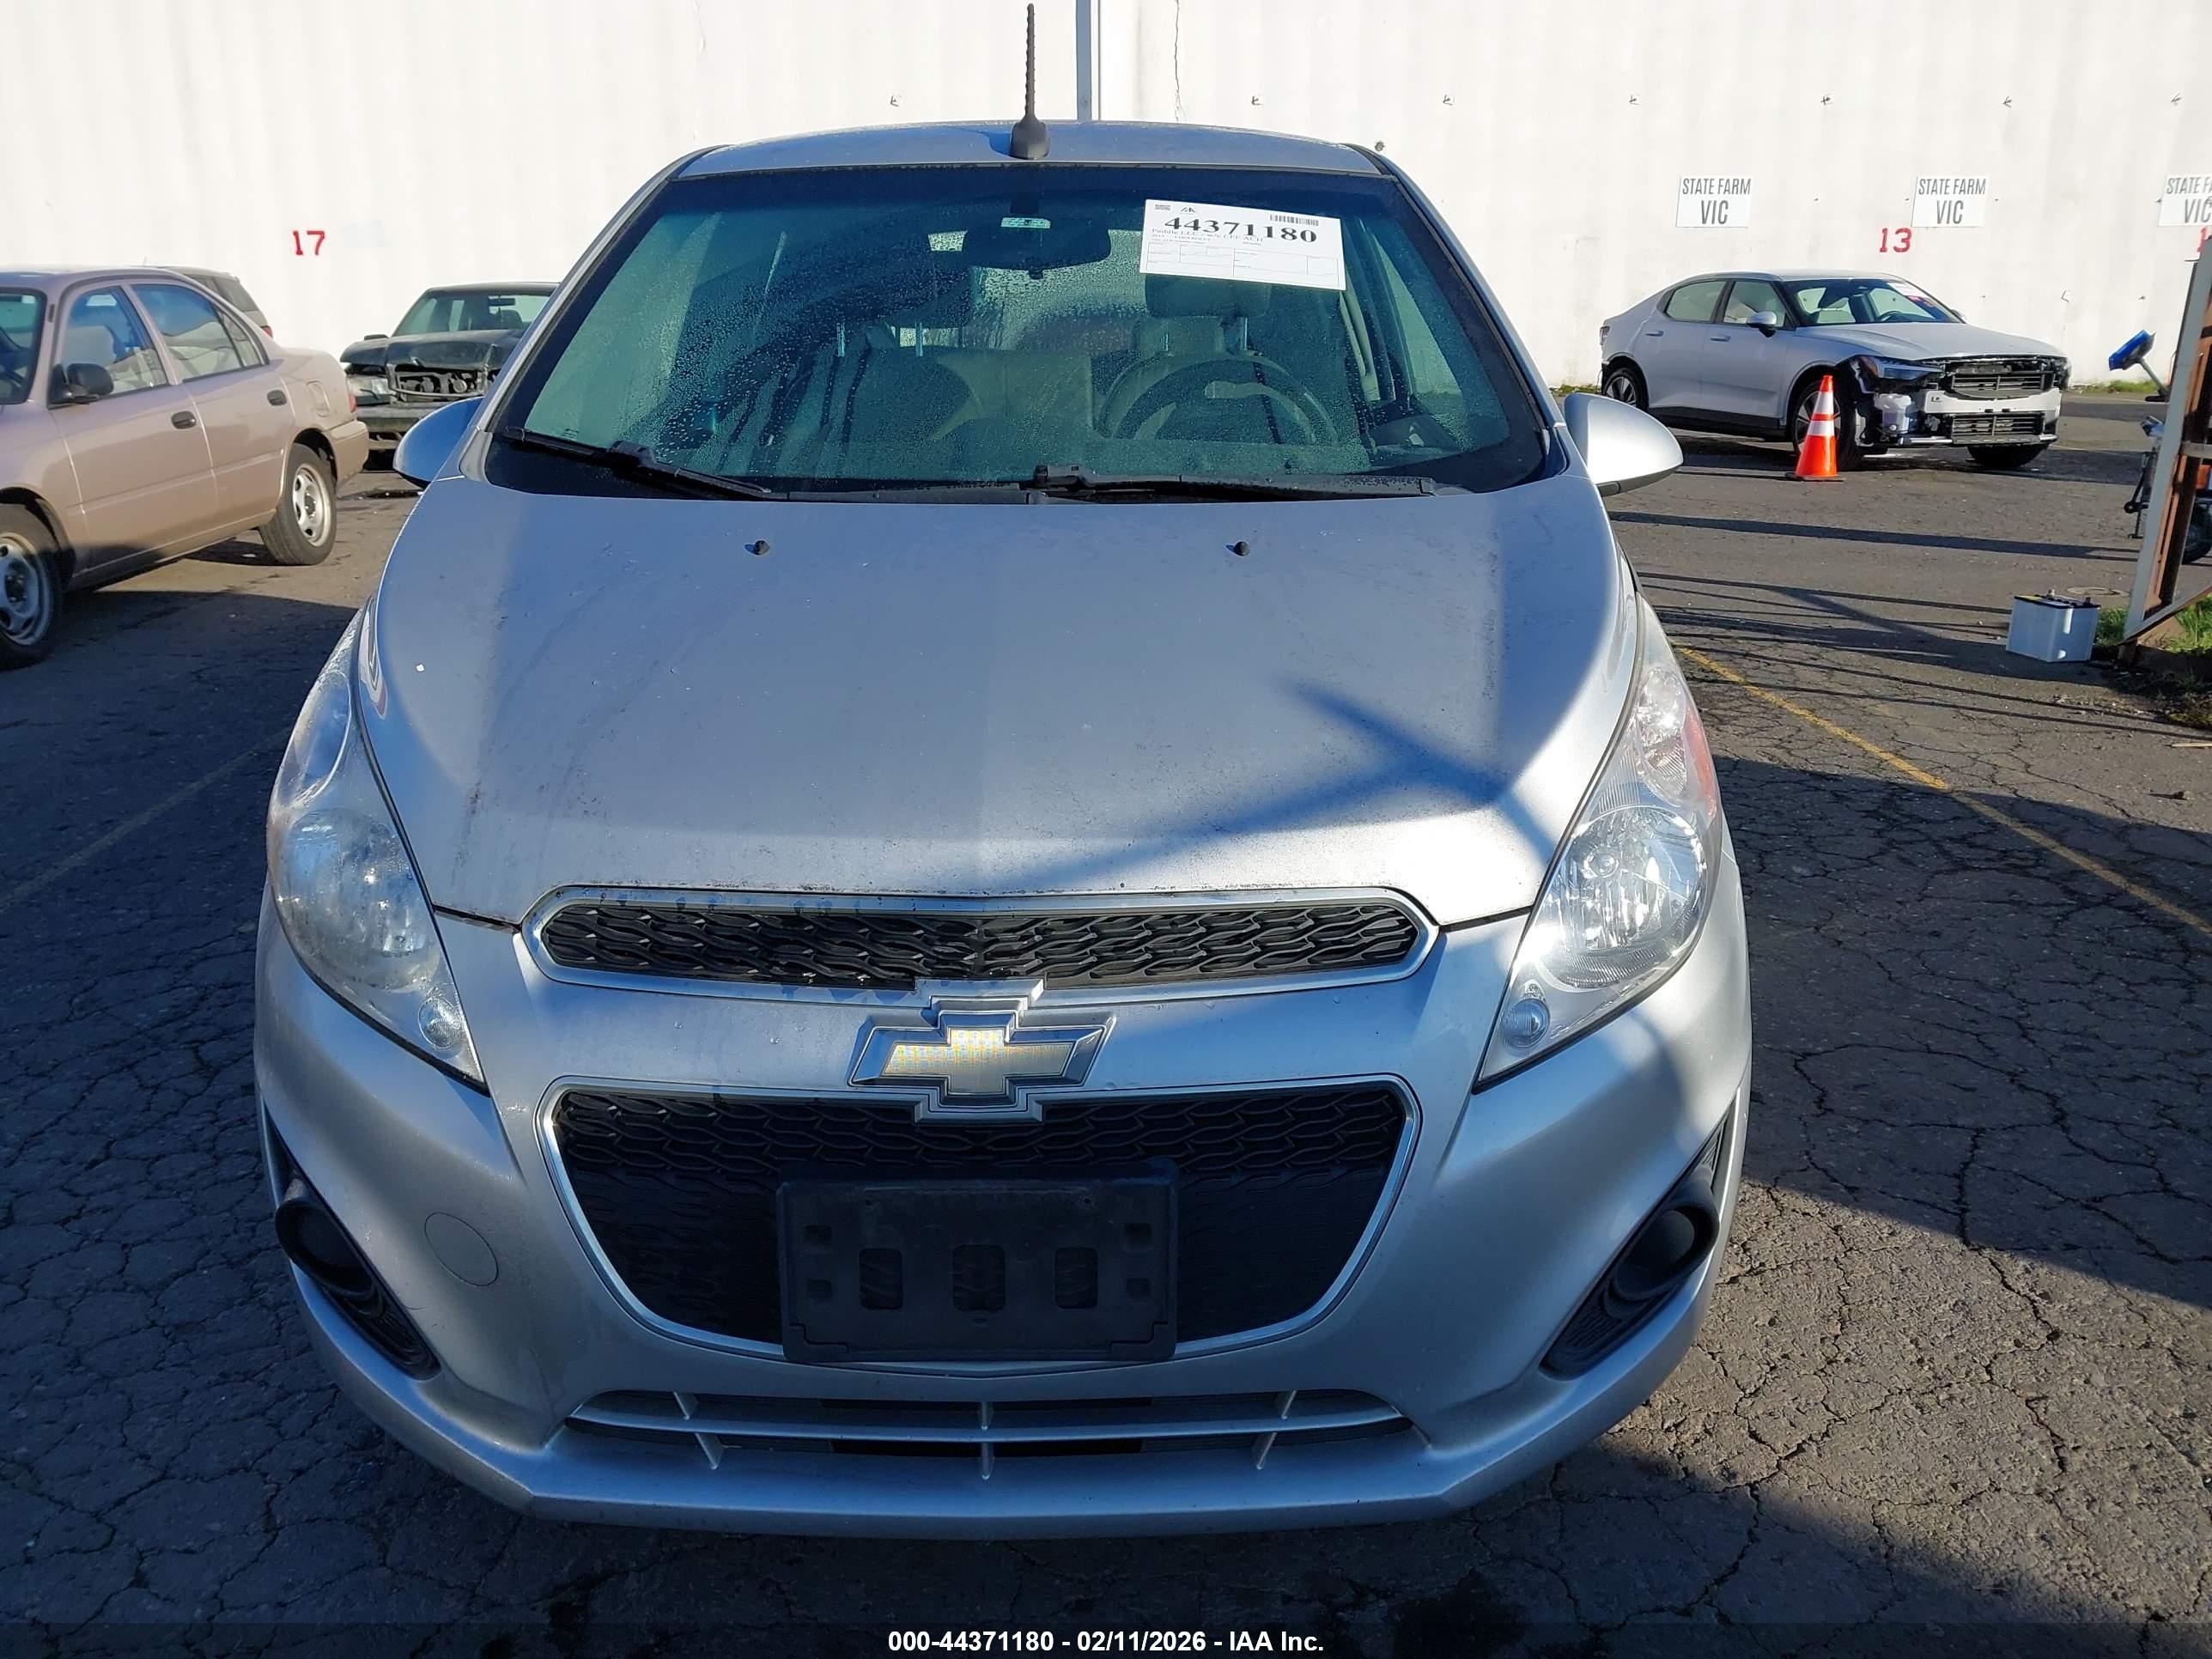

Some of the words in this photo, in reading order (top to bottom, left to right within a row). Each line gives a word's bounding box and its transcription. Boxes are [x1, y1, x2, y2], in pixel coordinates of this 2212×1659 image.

[1682, 178, 1716, 195] STATE
[1717, 178, 1752, 195] FARM
[1918, 178, 1951, 195] STATE
[1953, 178, 1987, 195] FARM
[2166, 177, 2202, 194] STATE
[1701, 199, 1729, 225] VIC
[1936, 199, 1964, 225] VIC
[2185, 198, 2212, 223] VIC
[1164, 216, 1317, 243] 44371180
[1879, 227, 1912, 253] 13
[293, 230, 325, 256] 17
